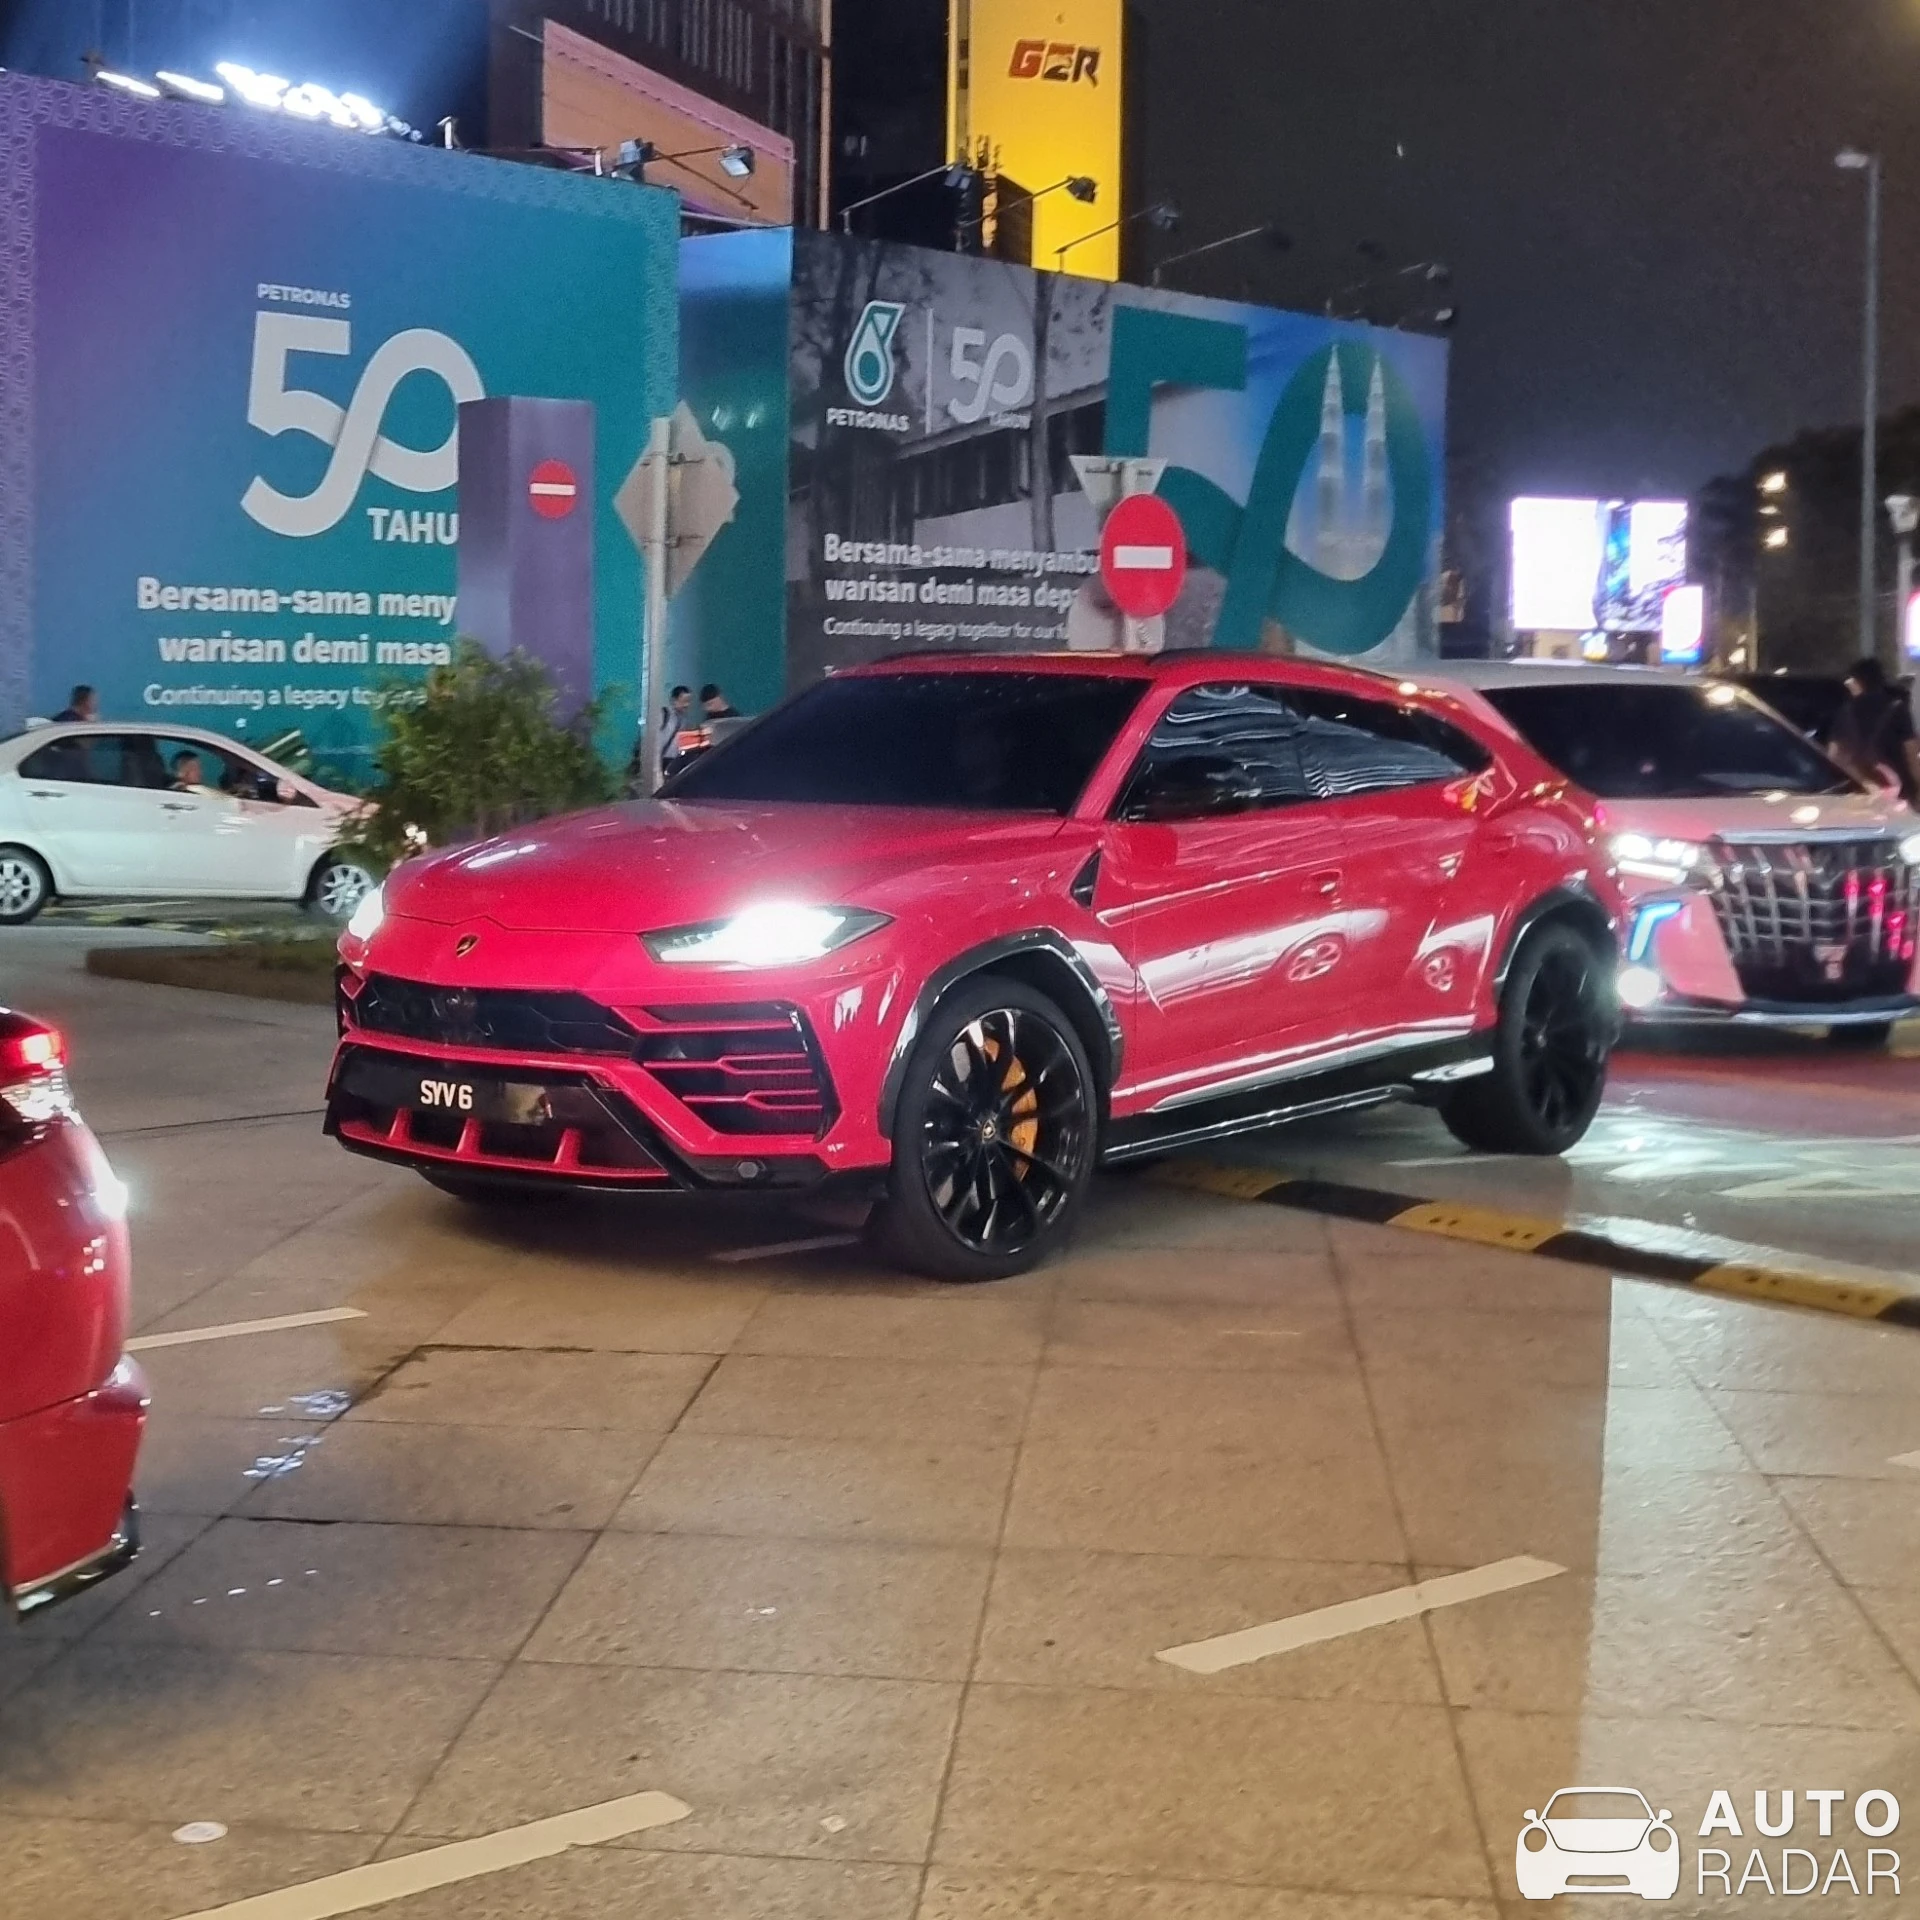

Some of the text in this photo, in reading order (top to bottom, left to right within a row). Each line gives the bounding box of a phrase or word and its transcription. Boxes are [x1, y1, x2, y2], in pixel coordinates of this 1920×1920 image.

[257, 283, 351, 309] PETRONAS
[948, 326, 1031, 424] 50
[240, 311, 486, 538] 50
[826, 407, 910, 432] PETRONAS
[367, 508, 459, 545] TAHU
[824, 533, 986, 568] Bersama-sama
[137, 577, 457, 625] Bersama-sama meny
[825, 574, 917, 602] warisan
[919, 576, 974, 605] demi
[976, 584, 1031, 606] masa
[823, 617, 902, 640] Continuing
[902, 623, 913, 637] a
[914, 618, 957, 641] legacy
[158, 630, 451, 665] warisan demi masa
[143, 683, 264, 710] Continuing
[267, 688, 281, 705] a
[284, 684, 349, 710] legacy
